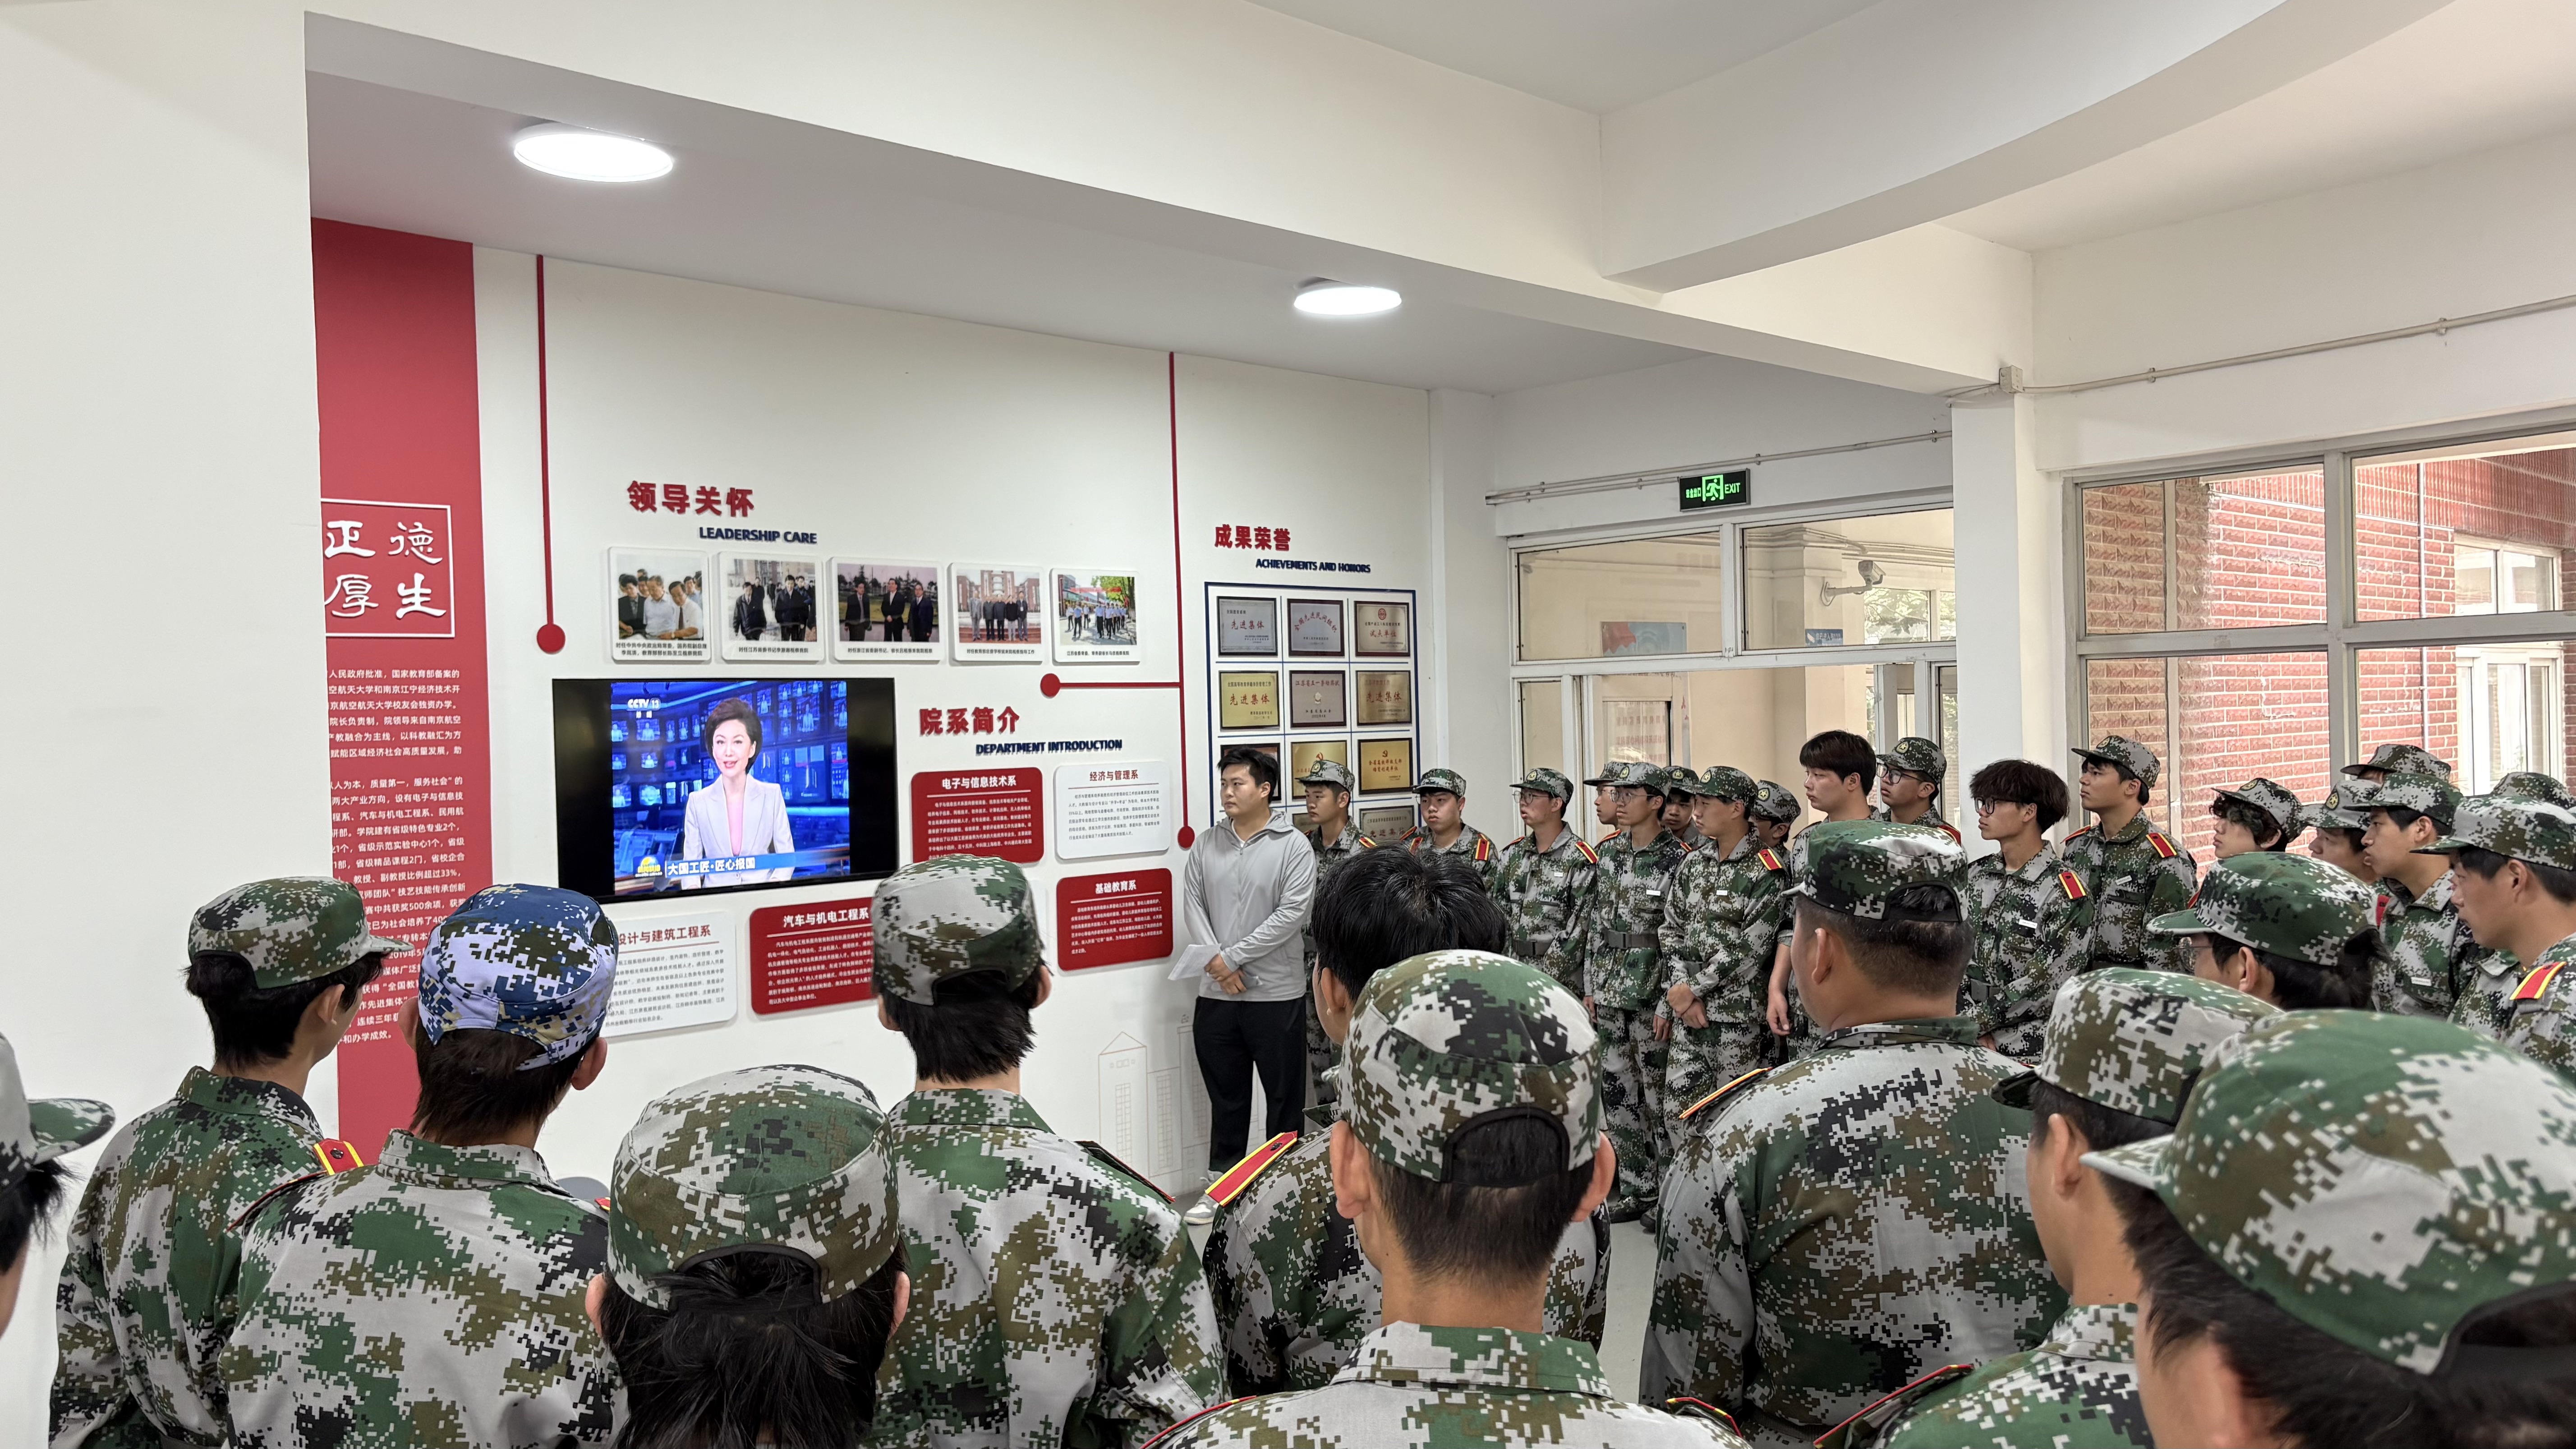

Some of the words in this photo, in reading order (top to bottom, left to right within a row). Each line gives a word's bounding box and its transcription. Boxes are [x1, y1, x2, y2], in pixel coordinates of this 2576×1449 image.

[1725, 483, 1740, 494] EXIT
[627, 481, 754, 517] 领导关怀
[325, 520, 443, 564] 正德
[699, 527, 780, 542] LEADERSHIP
[784, 531, 817, 544] CARE
[1214, 524, 1291, 551] 成果荣誉
[1256, 559, 1317, 571] ACHIEVEMENTS
[1319, 562, 1336, 571] AND
[1338, 563, 1371, 573] HONORS
[325, 573, 446, 619] 厚生
[1231, 619, 1264, 630] 先进集体
[329, 669, 460, 679] 人民政府批准，国家教育部备案的
[329, 685, 460, 694] 空航天大学和南京江宁经济技术开
[627, 699, 649, 709] CCTV
[652, 699, 659, 709] 13
[1230, 693, 1270, 705] 先进集体
[1366, 691, 1402, 703] 先进集体
[330, 716, 461, 726] 院长负责制，院领导来自南京航空
[920, 706, 1019, 735] 院系简介
[331, 746, 462, 758] 赋能区域经济社会高质量发展，助
[976, 742, 1045, 754] DEPARTMENT
[1048, 740, 1122, 752] INTRODUCTION
[942, 775, 1017, 790] 电子与信息技术系
[1090, 769, 1138, 782] 经济与管理系
[333, 807, 464, 822] 程系、汽车与机电工程系、民用航
[668, 857, 755, 876] 大国工匠·匠心报国
[1095, 880, 1136, 894] 基础教育系
[783, 907, 869, 928] 汽车与机电工程系
[619, 925, 711, 945] 设计与建筑工程系
